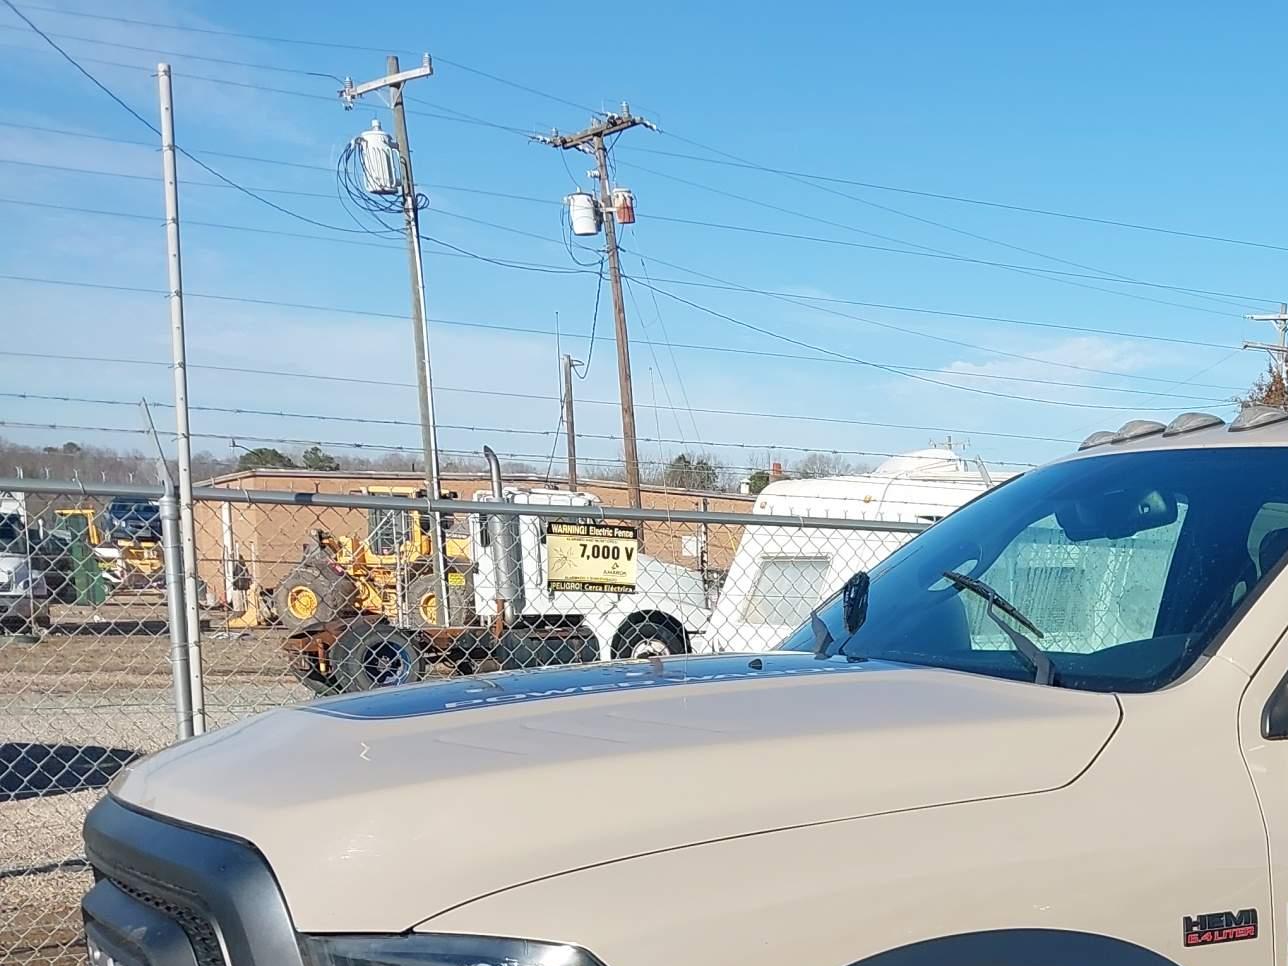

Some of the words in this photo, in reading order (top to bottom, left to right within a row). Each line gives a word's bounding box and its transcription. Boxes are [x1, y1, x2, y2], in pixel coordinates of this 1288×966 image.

[551, 523, 588, 535] WARNING!
[589, 525, 613, 537] Electric
[614, 528, 634, 538] Fence
[579, 543, 620, 560] 7,000
[625, 546, 634, 561] V
[1183, 908, 1258, 932] HEMI
[1187, 932, 1213, 945] 6.4
[1214, 926, 1255, 941] LITER
